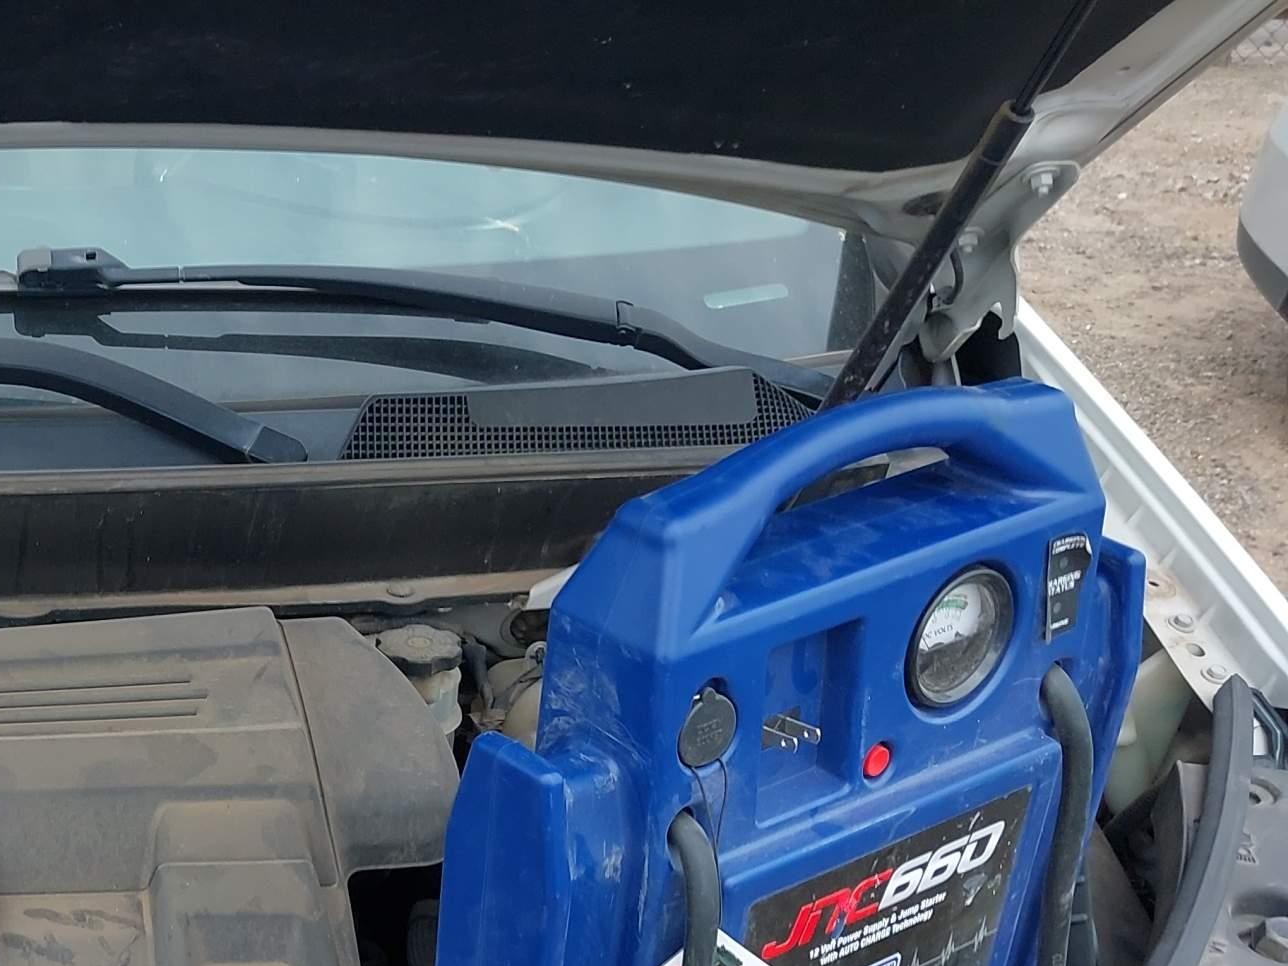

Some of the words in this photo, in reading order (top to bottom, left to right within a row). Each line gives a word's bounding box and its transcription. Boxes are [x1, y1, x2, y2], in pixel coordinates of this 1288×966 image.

[836, 929, 862, 950] Power
[863, 917, 890, 941] Supply
[890, 912, 898, 925] &
[897, 902, 920, 924] Jump
[919, 891, 947, 911] Starter
[838, 941, 860, 960] AUTO
[860, 928, 891, 953] CHARGE
[892, 909, 934, 938] Technology
